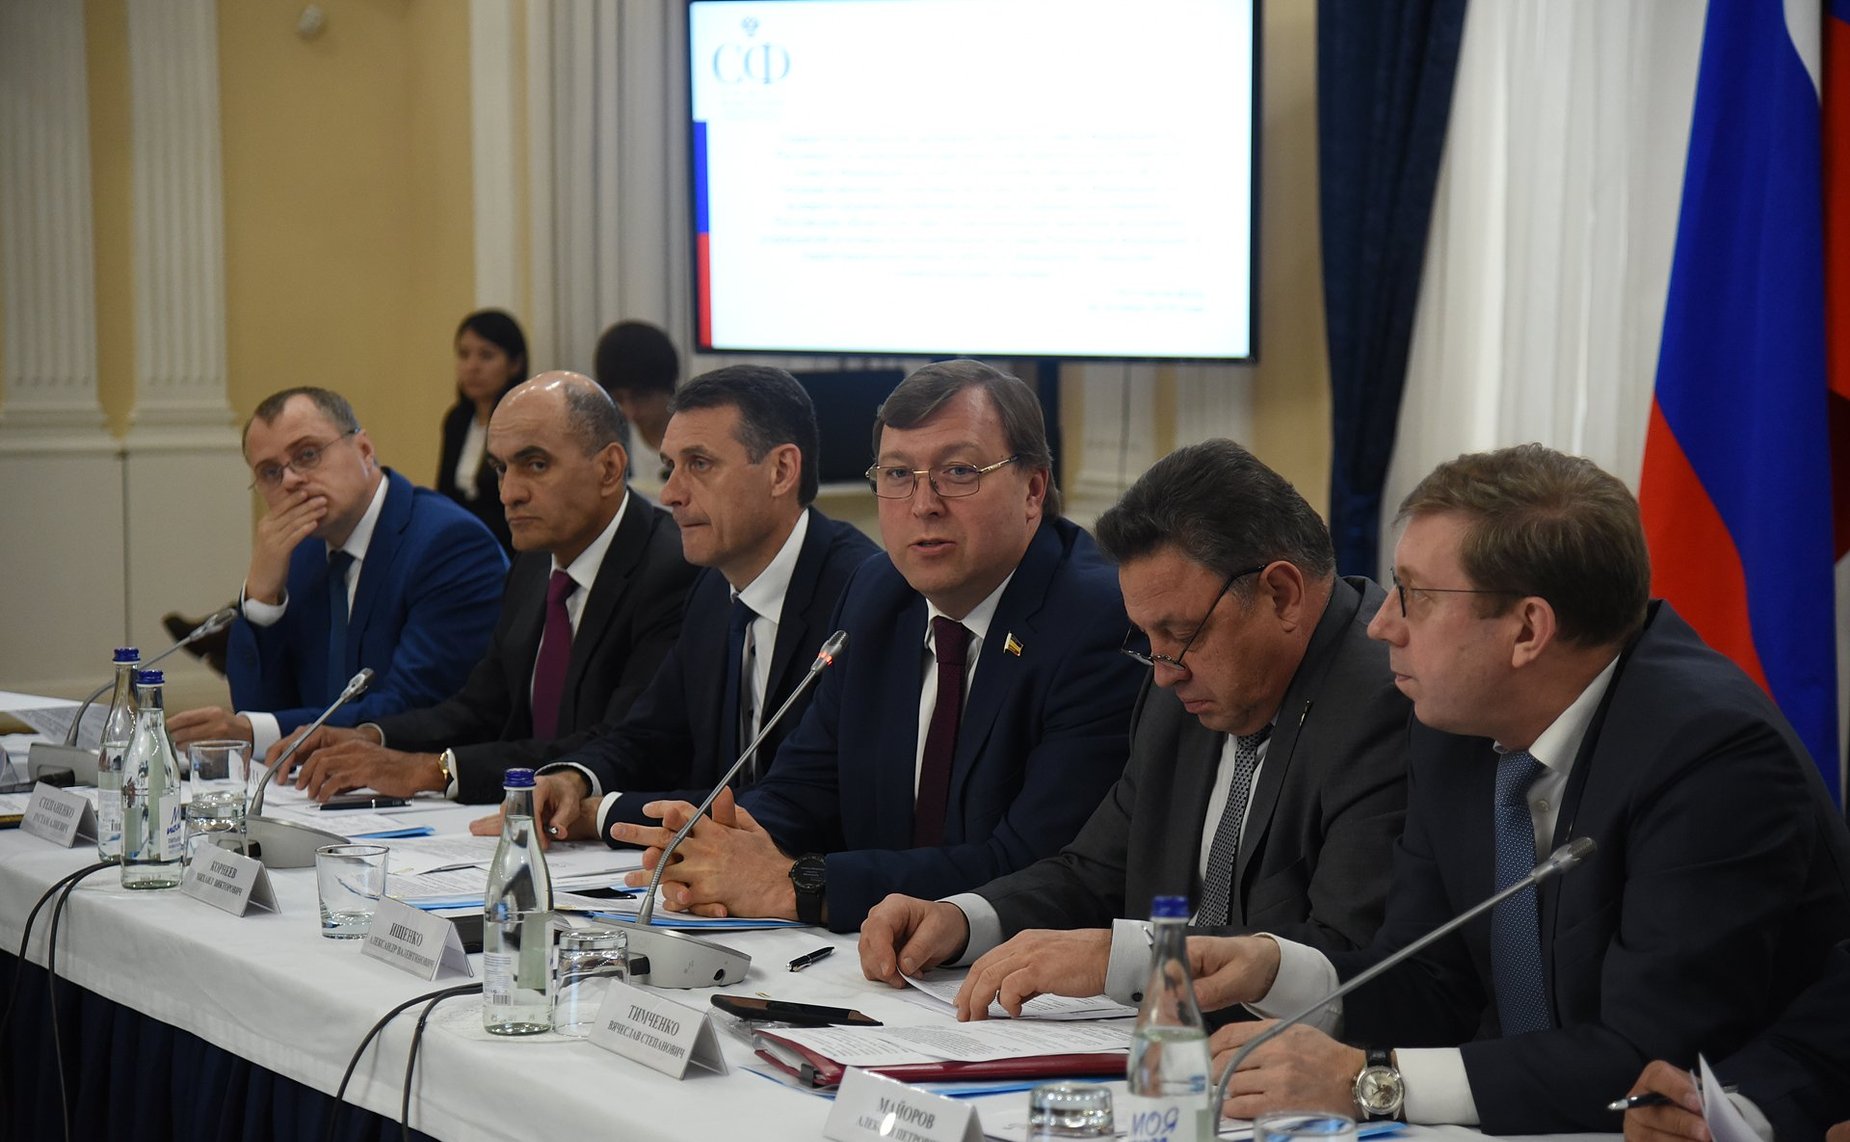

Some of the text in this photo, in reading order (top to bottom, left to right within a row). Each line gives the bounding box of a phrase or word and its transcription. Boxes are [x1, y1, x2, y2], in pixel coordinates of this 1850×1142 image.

[711, 42, 792, 85] СФ
[210, 860, 238, 879] КОРНЕЕВ
[389, 922, 424, 947] ИЩЕНКО
[627, 1004, 680, 1036] ТИМЧЕНКО
[607, 1020, 686, 1059] ВЯЧЕСЛАВ СТЕПАНОВИЧ
[877, 1096, 936, 1129] МАЙОРОВ
